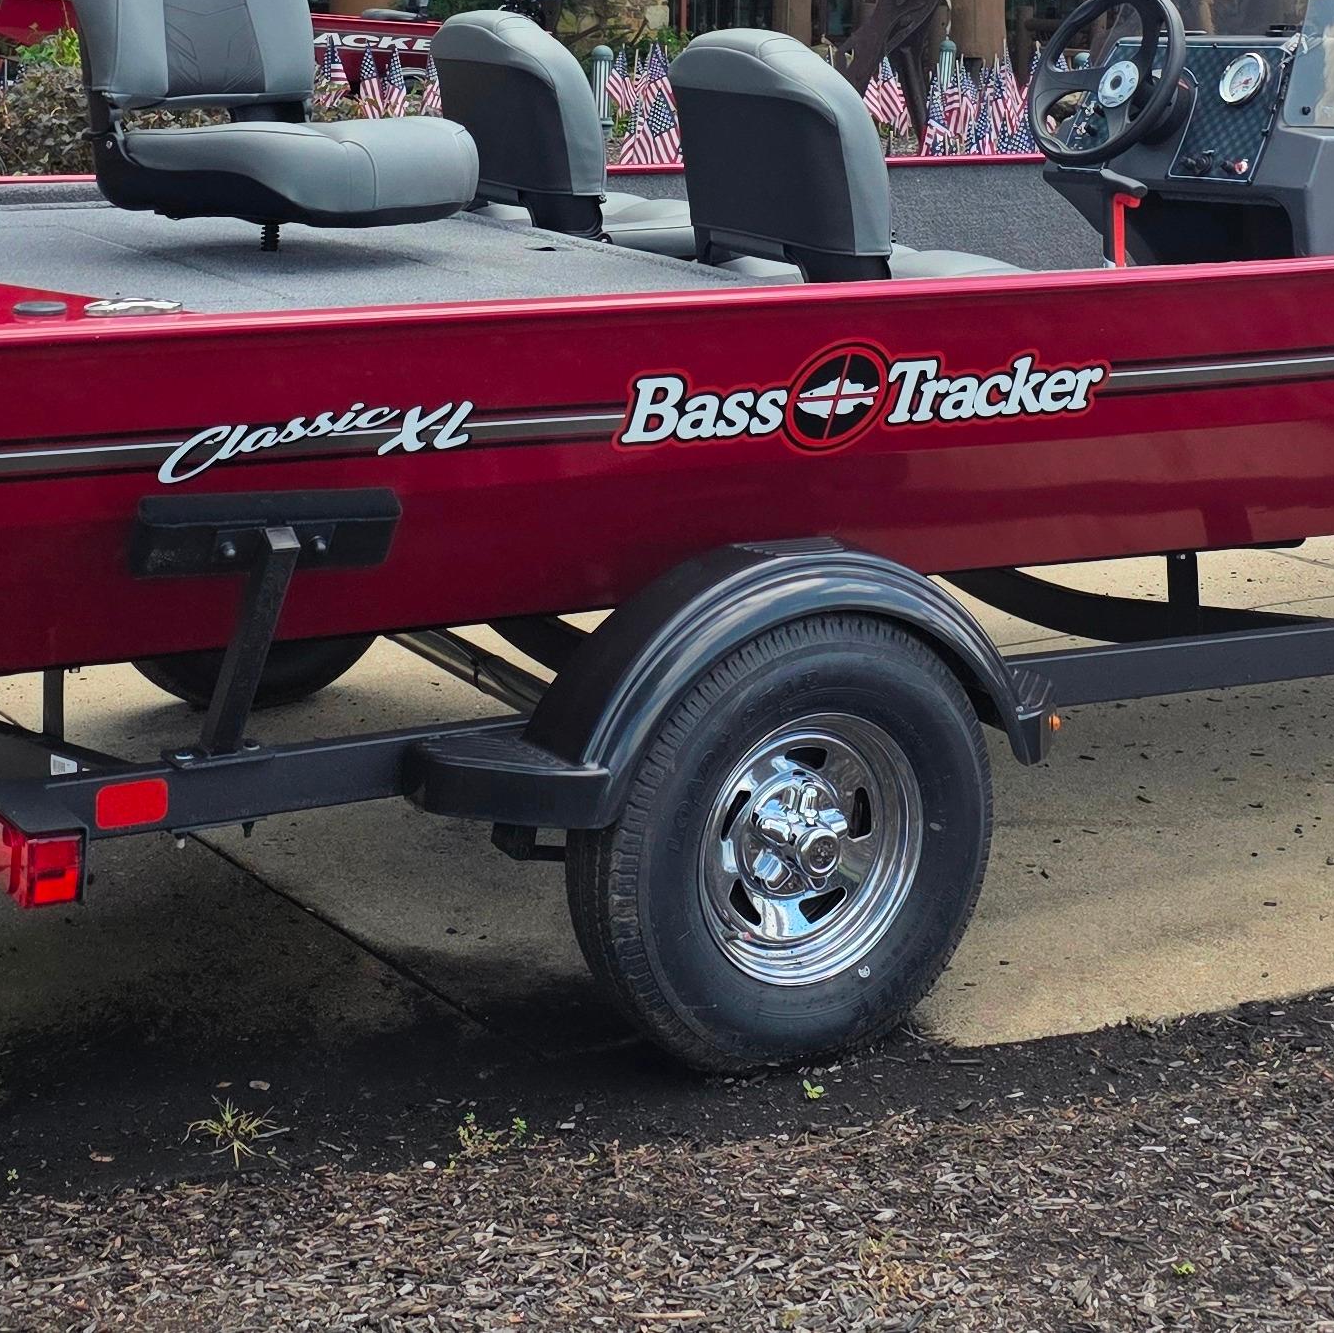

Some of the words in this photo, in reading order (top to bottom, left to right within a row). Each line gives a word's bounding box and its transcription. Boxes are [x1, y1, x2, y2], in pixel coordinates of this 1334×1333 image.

[313, 32, 432, 51] ACKE
[622, 377, 788, 443] Bass
[887, 356, 1104, 424] Tracker
[157, 403, 401, 483] Classic
[378, 401, 475, 457] XL
